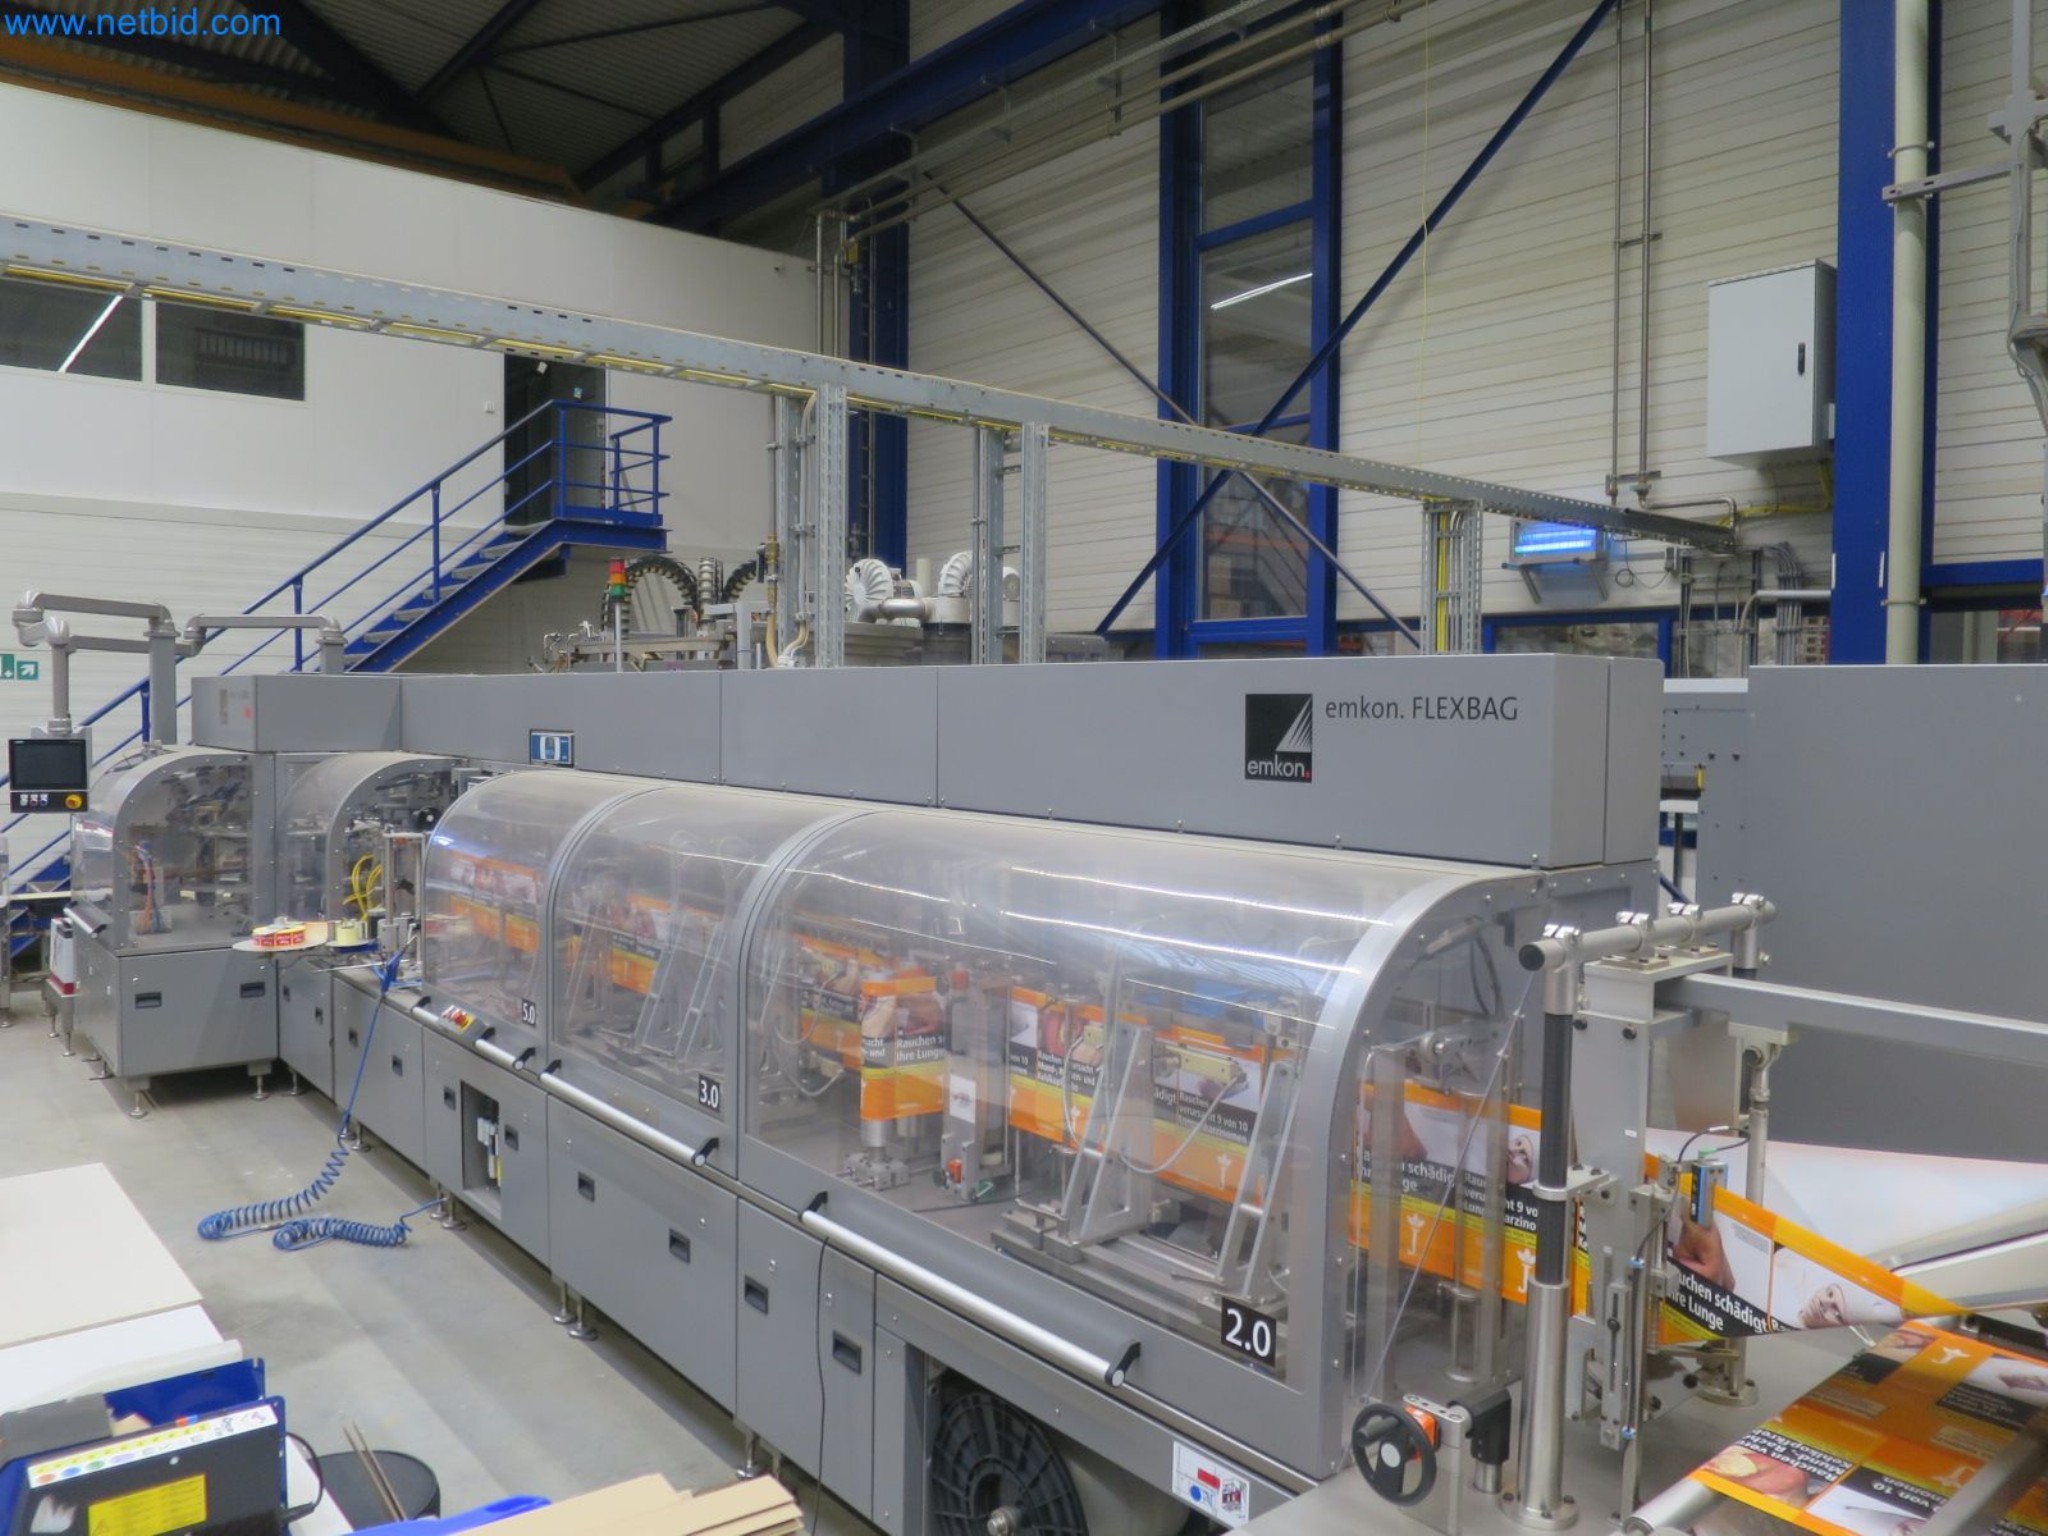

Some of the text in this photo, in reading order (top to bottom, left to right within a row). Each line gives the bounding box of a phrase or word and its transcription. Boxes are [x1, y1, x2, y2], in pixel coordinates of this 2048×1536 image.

[1325, 695, 1518, 721] emkon. FLEXBAG
[1247, 754, 1311, 779] emkon.
[700, 1079, 719, 1109] 3.0
[1688, 1295, 1724, 1331] Lunge
[1225, 1308, 1272, 1358] 2.0
[1872, 1482, 1931, 1508] von 10
